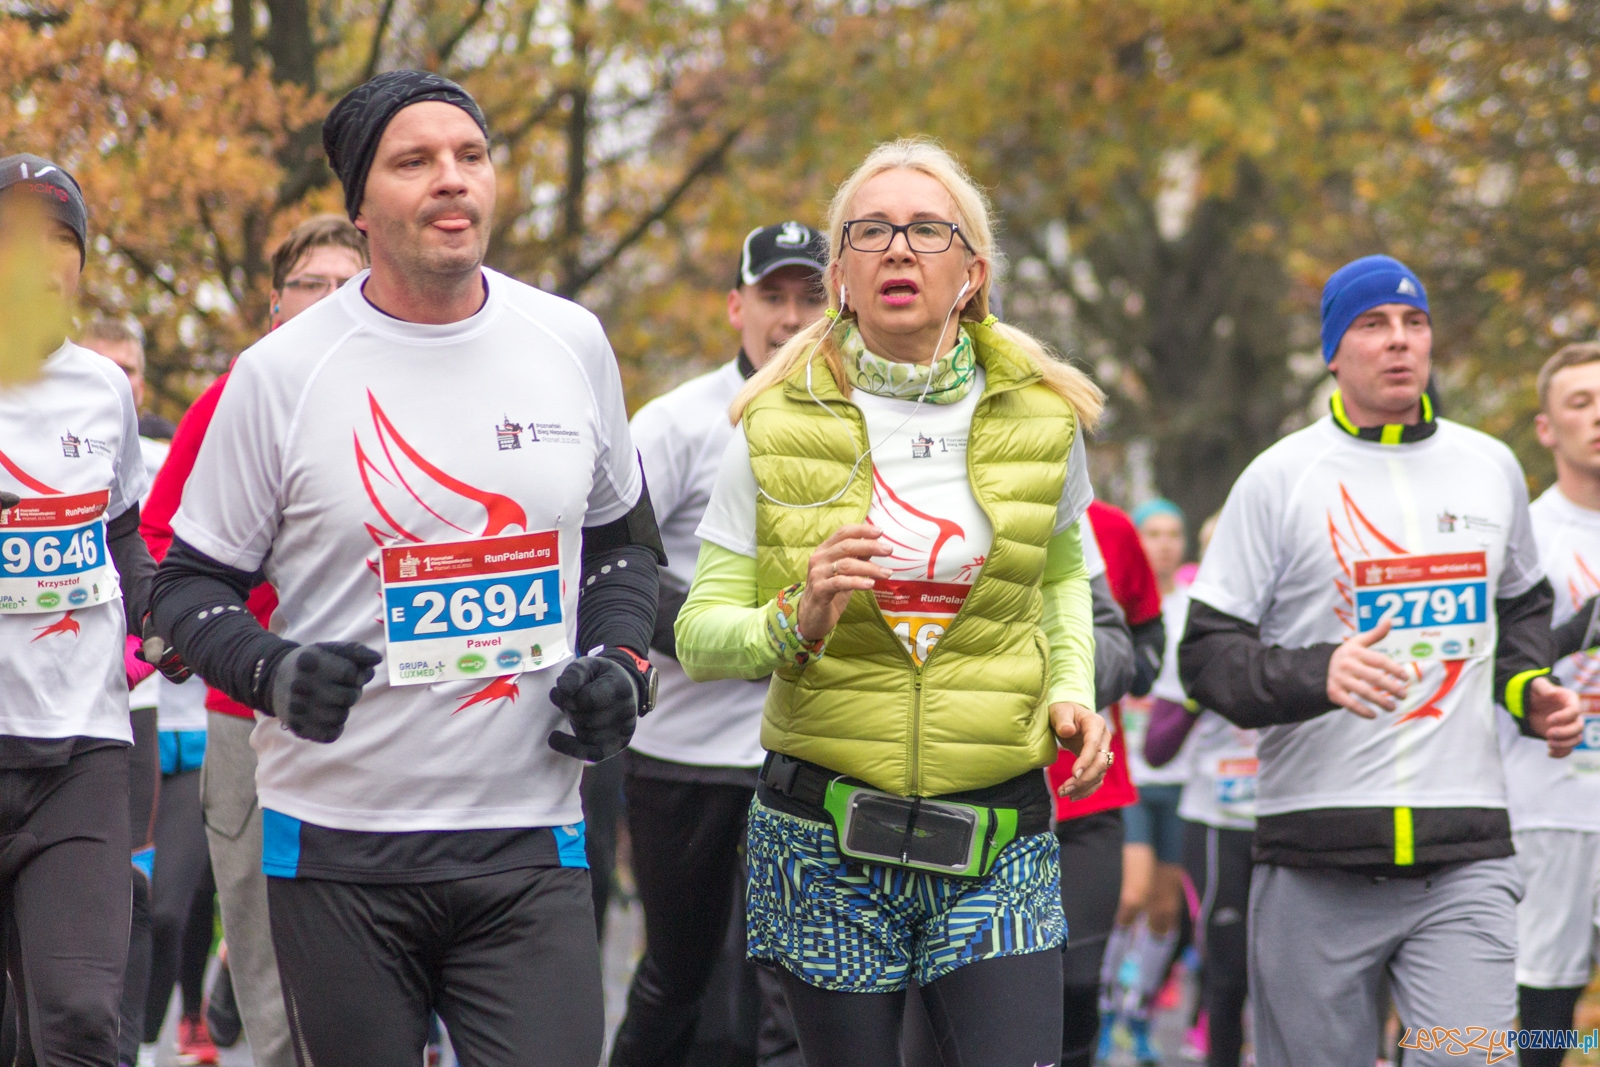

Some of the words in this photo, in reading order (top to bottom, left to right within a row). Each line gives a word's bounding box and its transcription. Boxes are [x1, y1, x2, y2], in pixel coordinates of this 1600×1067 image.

[528, 422, 541, 442] 1
[938, 437, 949, 453] 1
[13, 508, 22, 521] 1
[1, 529, 98, 574] 9646
[484, 548, 551, 564] RunPoland.org
[422, 557, 434, 572] 1
[37, 577, 81, 589] Krzysztof
[391, 607, 406, 623] E
[412, 578, 548, 635] 2694
[1374, 585, 1478, 628] 2791
[466, 637, 502, 649] Paweł
[399, 661, 429, 670] GRUPA
[400, 669, 435, 679] LUXMED
